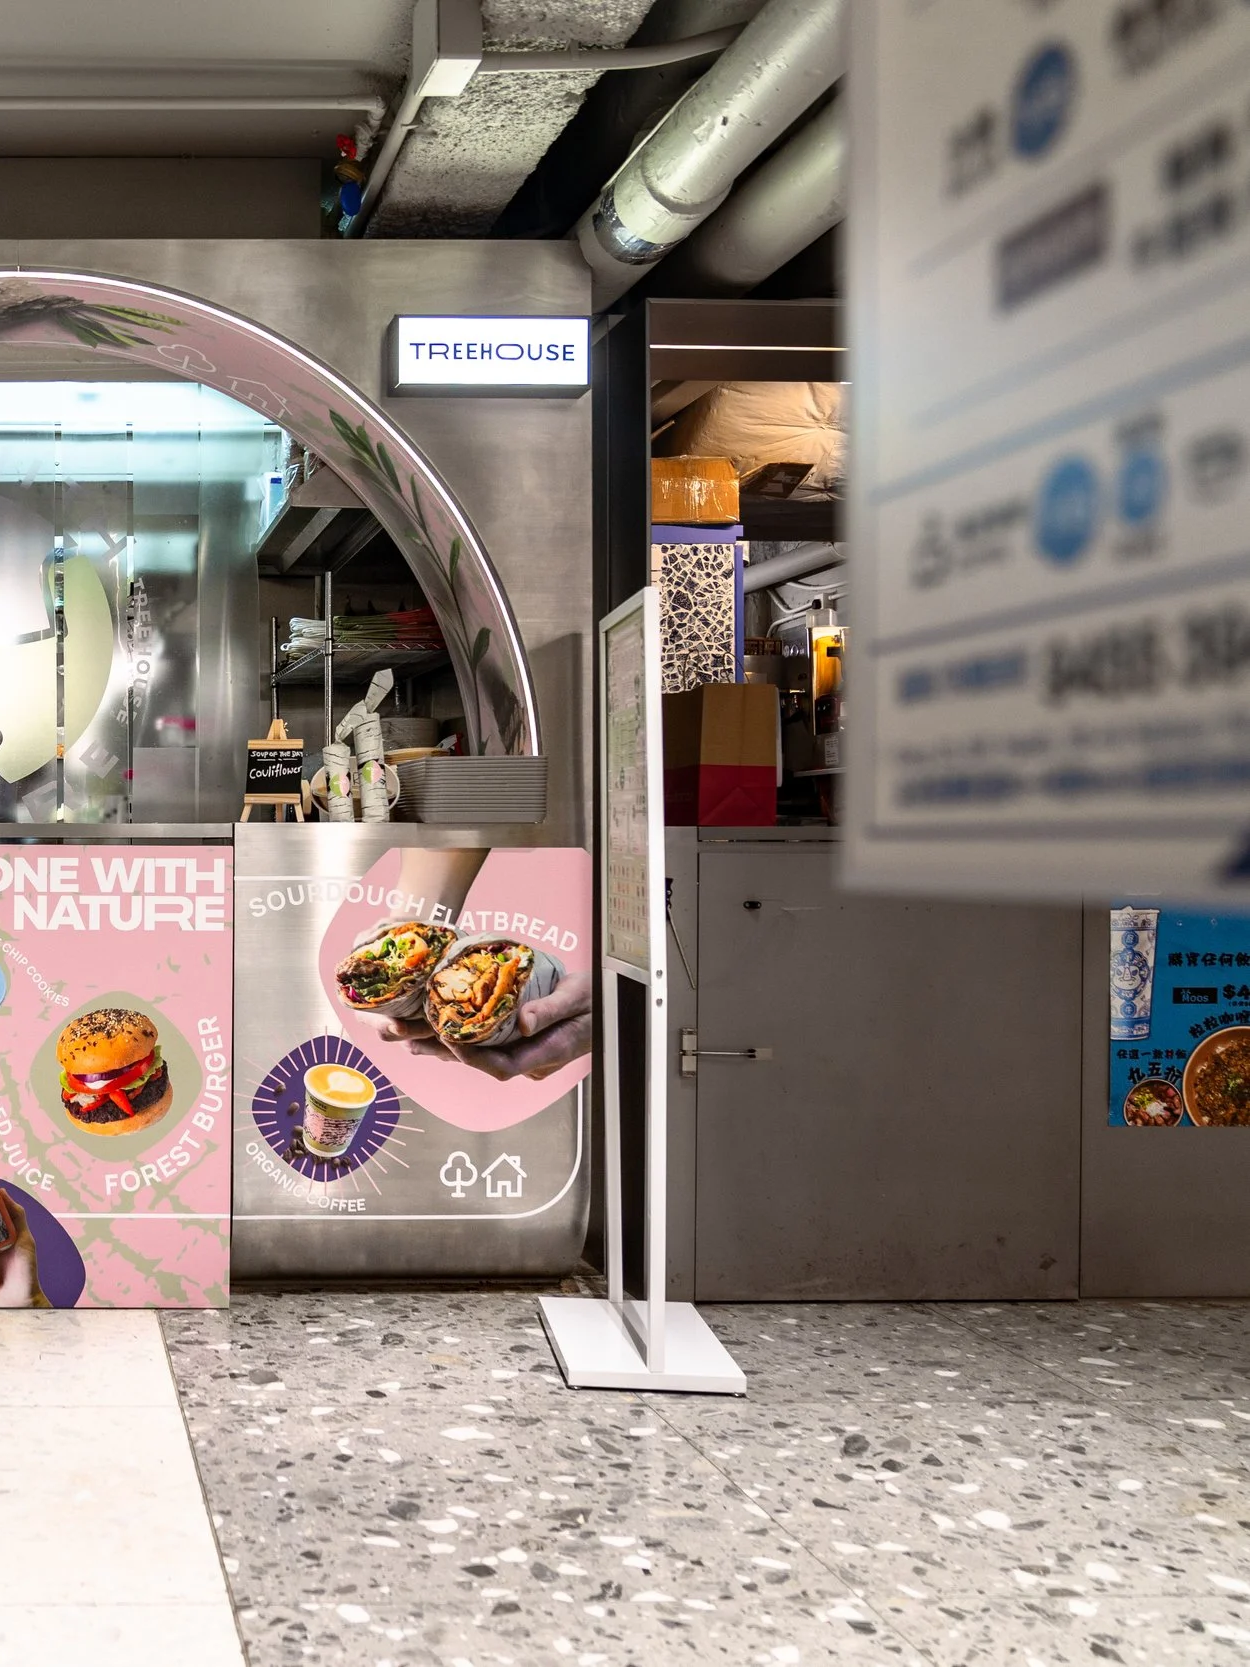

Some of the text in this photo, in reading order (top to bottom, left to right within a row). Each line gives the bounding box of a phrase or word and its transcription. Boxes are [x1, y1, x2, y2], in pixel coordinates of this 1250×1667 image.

[410, 343, 575, 361] TREEHOUSE
[116, 577, 152, 725] TREEHOUSE
[250, 750, 268, 758] SOUP
[91, 858, 225, 893] WITH
[13, 895, 225, 931] NATURE
[248, 880, 579, 953] SOURDOUGH FLATBREAD
[1, 943, 29, 967] CHIP
[25, 964, 70, 1008] COOKIES
[104, 1015, 229, 1196] FOREST BURGER
[1, 1134, 56, 1191] JUICE
[245, 1141, 367, 1212] ORGANIC COFFEE
